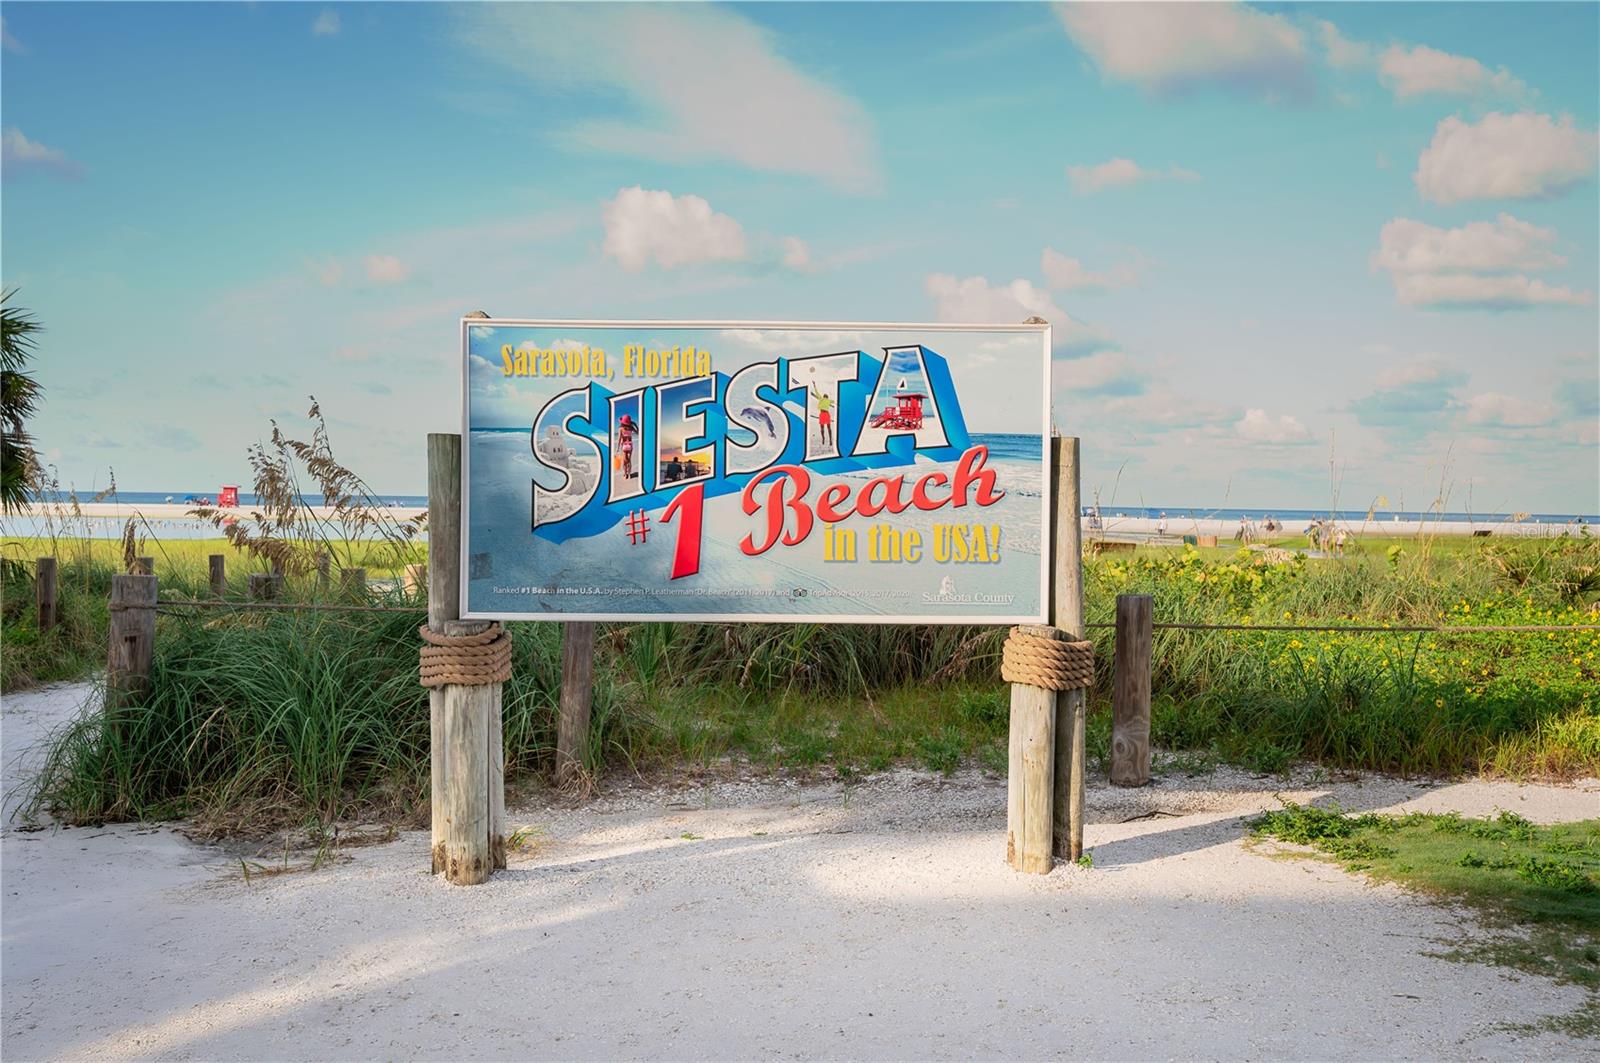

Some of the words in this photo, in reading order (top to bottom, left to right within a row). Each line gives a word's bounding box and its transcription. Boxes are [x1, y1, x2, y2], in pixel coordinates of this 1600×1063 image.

[501, 345, 615, 381] Sarasota,
[623, 344, 712, 377] Florida
[531, 344, 951, 534] SIESTA
[739, 445, 1006, 555] Beach
[823, 523, 856, 562] in
[867, 523, 922, 562] the
[932, 523, 1001, 563] USA!
[493, 586, 519, 594] Ranked
[521, 586, 530, 594] #1
[532, 586, 555, 594] Beach
[556, 586, 564, 594] in
[565, 586, 578, 594] the
[580, 586, 603, 595] U.S.A.
[604, 586, 613, 596] by
[614, 587, 643, 597] Stephen
[652, 587, 693, 596] Leatherman
[922, 592, 971, 602] Sarasota
[974, 592, 1014, 604] County
